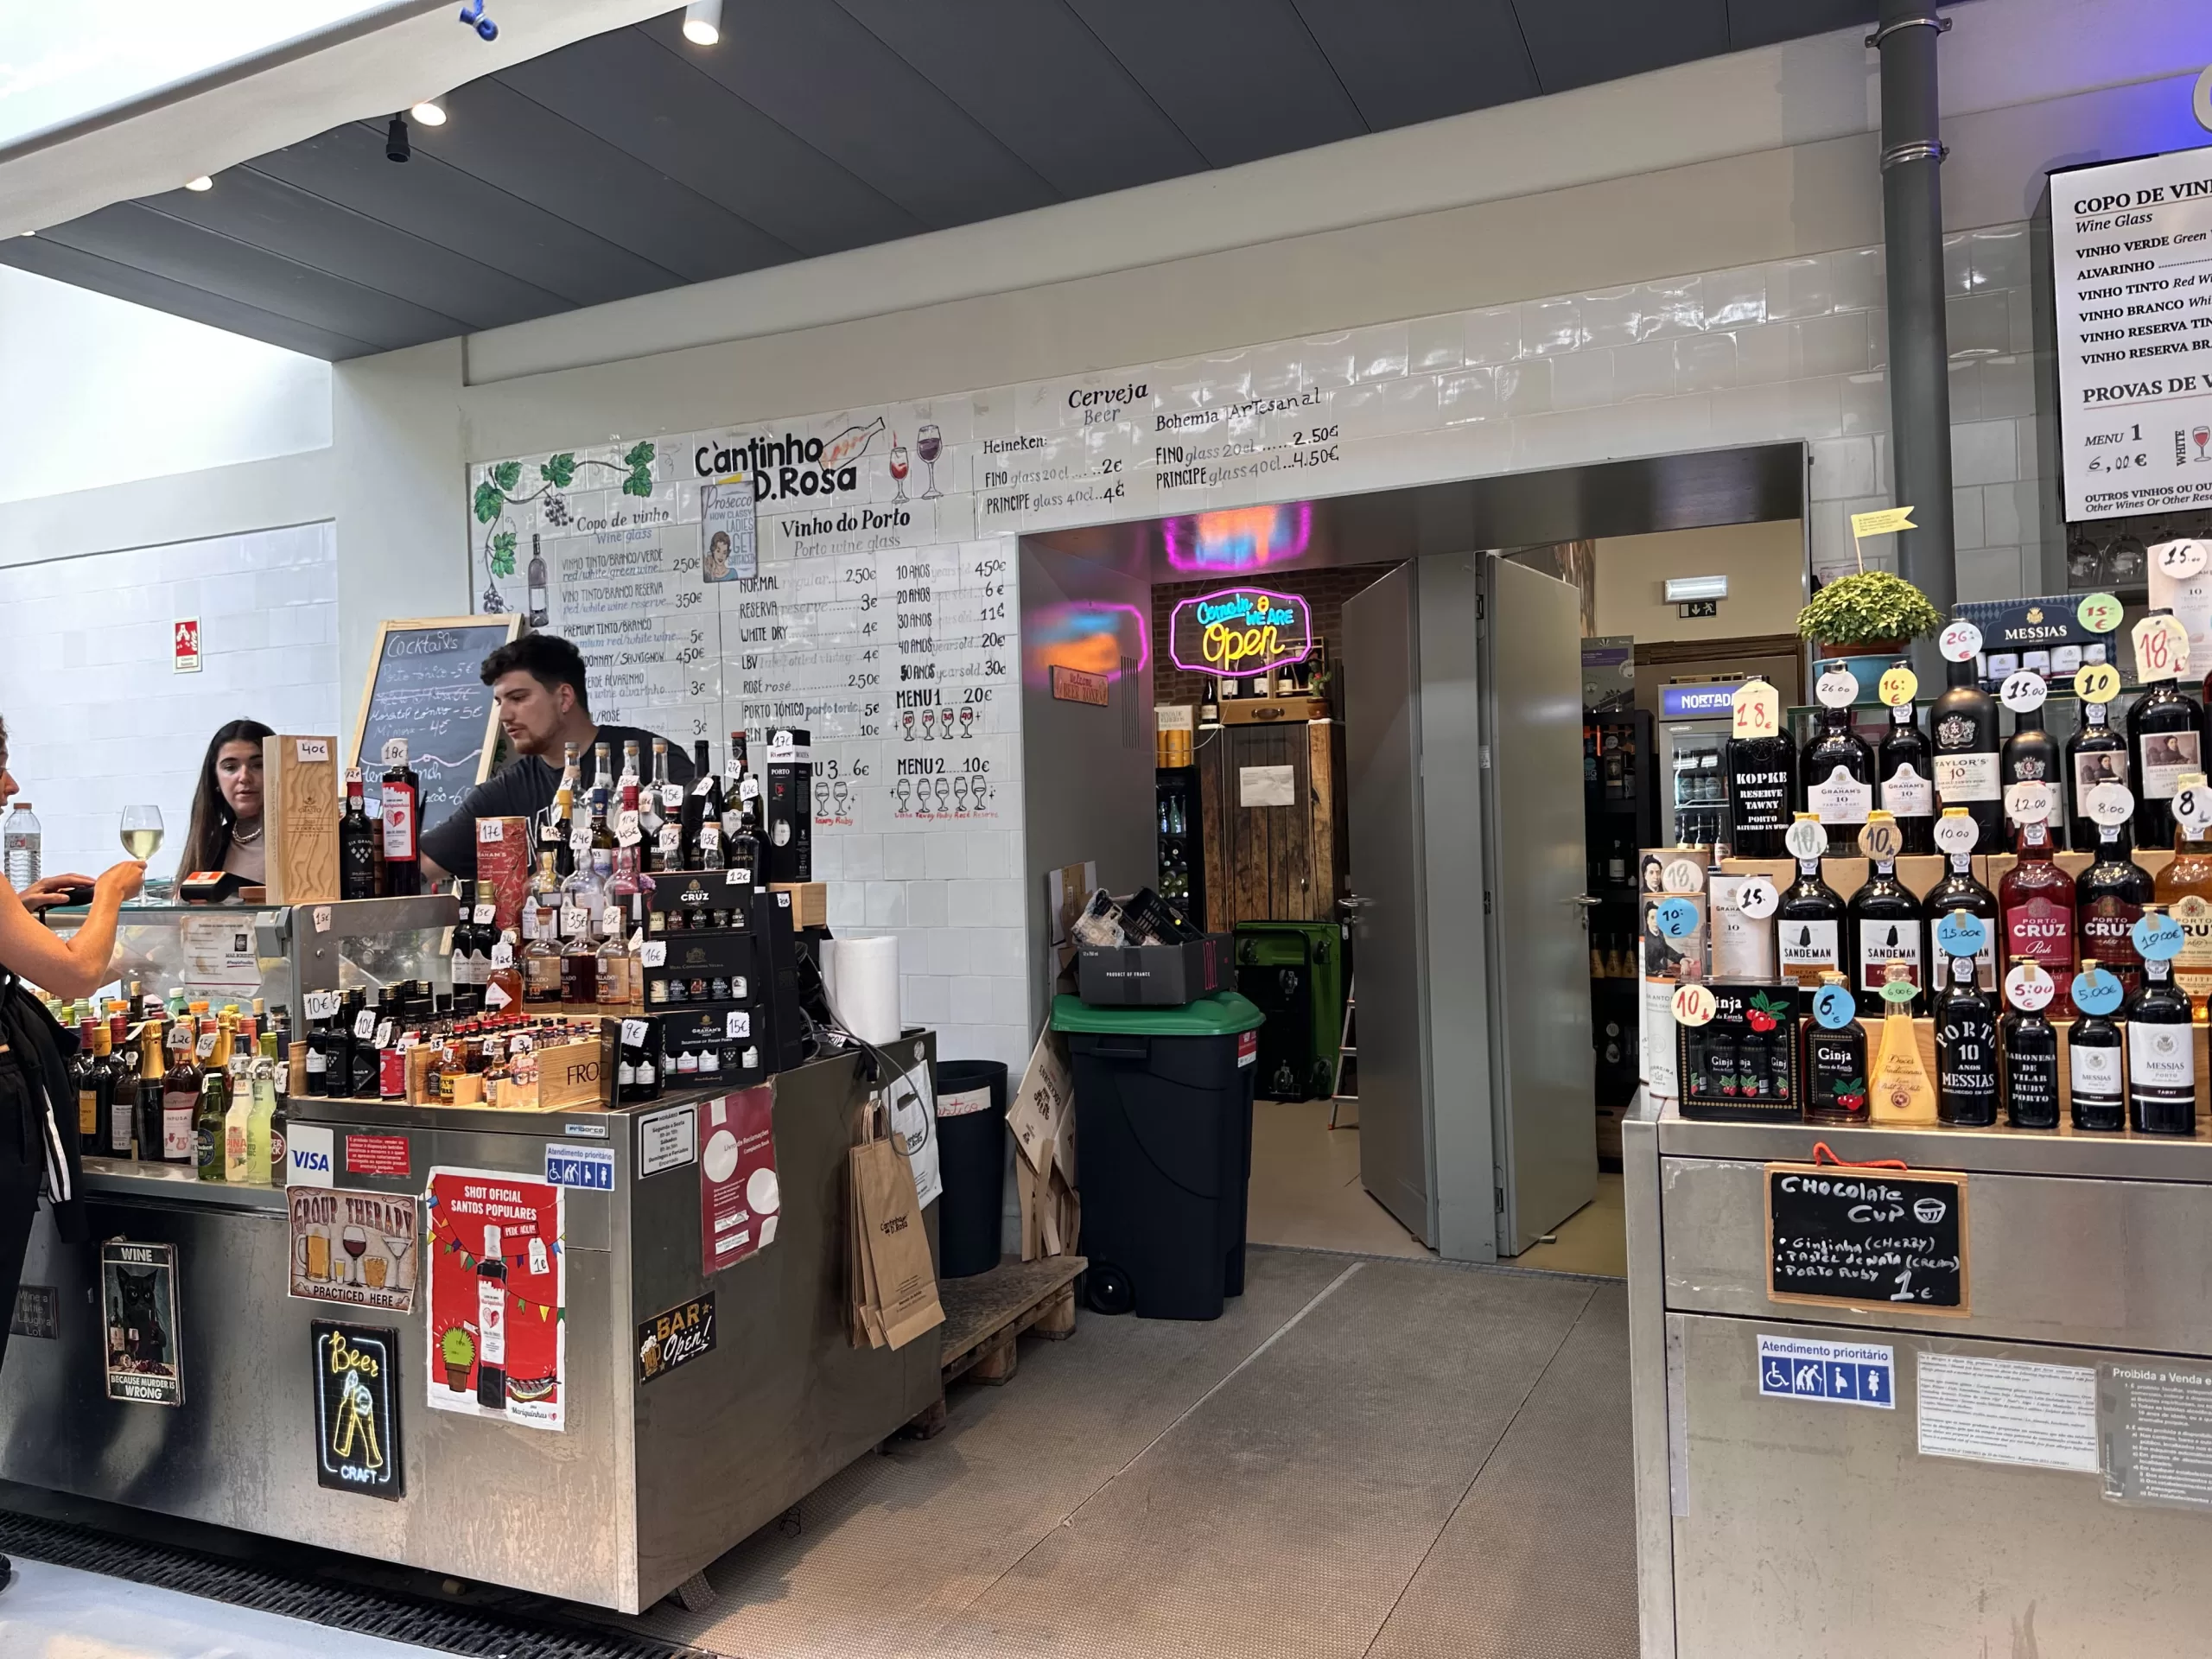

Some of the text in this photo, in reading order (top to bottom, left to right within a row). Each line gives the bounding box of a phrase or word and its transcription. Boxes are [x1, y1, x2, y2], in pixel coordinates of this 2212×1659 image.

[2075, 194, 2131, 214] COPO
[2137, 188, 2164, 206] DE
[2076, 213, 2153, 234] Wine Glass
[2076, 232, 2207, 259] VINHO VERDE Green
[2077, 260, 2155, 281] ALVARINHO
[2078, 276, 2195, 301] VINHO TINTO Red
[2079, 300, 2184, 322] VINHO BRANCO
[2080, 321, 2188, 344] VINHO RESERVA
[1068, 383, 1148, 410] Cerveja
[2083, 376, 2196, 404] PROVAS DE
[1084, 408, 1121, 426] Beer
[1155, 412, 1220, 432] Bohemia
[2084, 424, 2143, 447] MENU 1
[1156, 446, 1184, 465] FINO
[1185, 445, 1219, 467] glass
[985, 472, 1007, 487] FINO
[1011, 471, 1043, 488] glass
[1103, 459, 1122, 474] 2€
[1156, 467, 1207, 490] PRINCIPE
[1209, 467, 1247, 486] glass
[704, 485, 753, 519] Prosecco
[2085, 484, 2193, 503] OUTROS VINHOS OU
[987, 493, 1030, 515] PRINCIPE
[1033, 493, 1063, 512] glass
[2086, 495, 2190, 513] Other Wines Or Other
[577, 508, 669, 534] Copo de vinho
[709, 508, 753, 521] HOW CLASSY
[781, 508, 910, 538] Vinho do Porto
[726, 518, 754, 532] LADIES
[596, 529, 652, 545] Wine glass
[732, 531, 754, 554] GET
[794, 534, 900, 558] Porto wine glass
[563, 556, 583, 570] VINHO
[896, 565, 907, 580] 10
[909, 564, 930, 579] ANOS
[740, 576, 780, 594] NORMAL
[1245, 608, 1294, 626] WE ARE
[741, 627, 767, 643] WHITE
[772, 626, 789, 640] DRY
[2005, 625, 2068, 641] MESSIAS
[899, 632, 1005, 655] 40 ANOS 20€
[1202, 623, 1286, 671] Open
[741, 656, 758, 670] LBV
[766, 681, 791, 693] rosé
[2083, 674, 2109, 696] 10
[896, 687, 992, 709] MENU 1 20€
[1681, 691, 1733, 709] NORTAD
[744, 704, 770, 719] PORTO
[897, 757, 990, 775] MENU 2 10€
[1949, 767, 1966, 780] 10
[1736, 772, 1788, 785] KOPKE
[1739, 789, 1783, 799] RESERVE
[1745, 800, 1779, 810] TAWNY
[1748, 815, 1777, 823] PORTO
[681, 893, 709, 902] CRUZ
[2013, 924, 2067, 938] CRUZ
[1867, 948, 1916, 958] SANDEMAN
[1936, 1020, 1996, 1048] PORTO
[1817, 1046, 1853, 1062] Ginja
[1958, 1044, 1980, 1061] 10
[1942, 1072, 1994, 1088] MESSIAS
[2012, 1073, 2048, 1083] VILAR
[2014, 1084, 2046, 1092] RUBY
[2012, 1093, 2050, 1103] PORTO
[290, 1150, 329, 1172] VISA
[464, 1185, 523, 1204] SHOT OFICIAL
[293, 1196, 413, 1238] GROUP THERAPY
[451, 1199, 537, 1221] SANTOS POPULARES
[121, 1247, 153, 1262] WINE
[314, 1285, 393, 1306] PRACTICED HERE
[657, 1303, 701, 1342] BAR
[329, 1331, 378, 1378] Beer
[1762, 1340, 1889, 1362] Atendimento prioritário
[111, 1375, 175, 1389] BECAUSE MURDER IS
[2113, 1367, 2202, 1385] Proibida a Venda
[125, 1385, 162, 1399] WRONG
[340, 1465, 378, 1484] CRAFT
